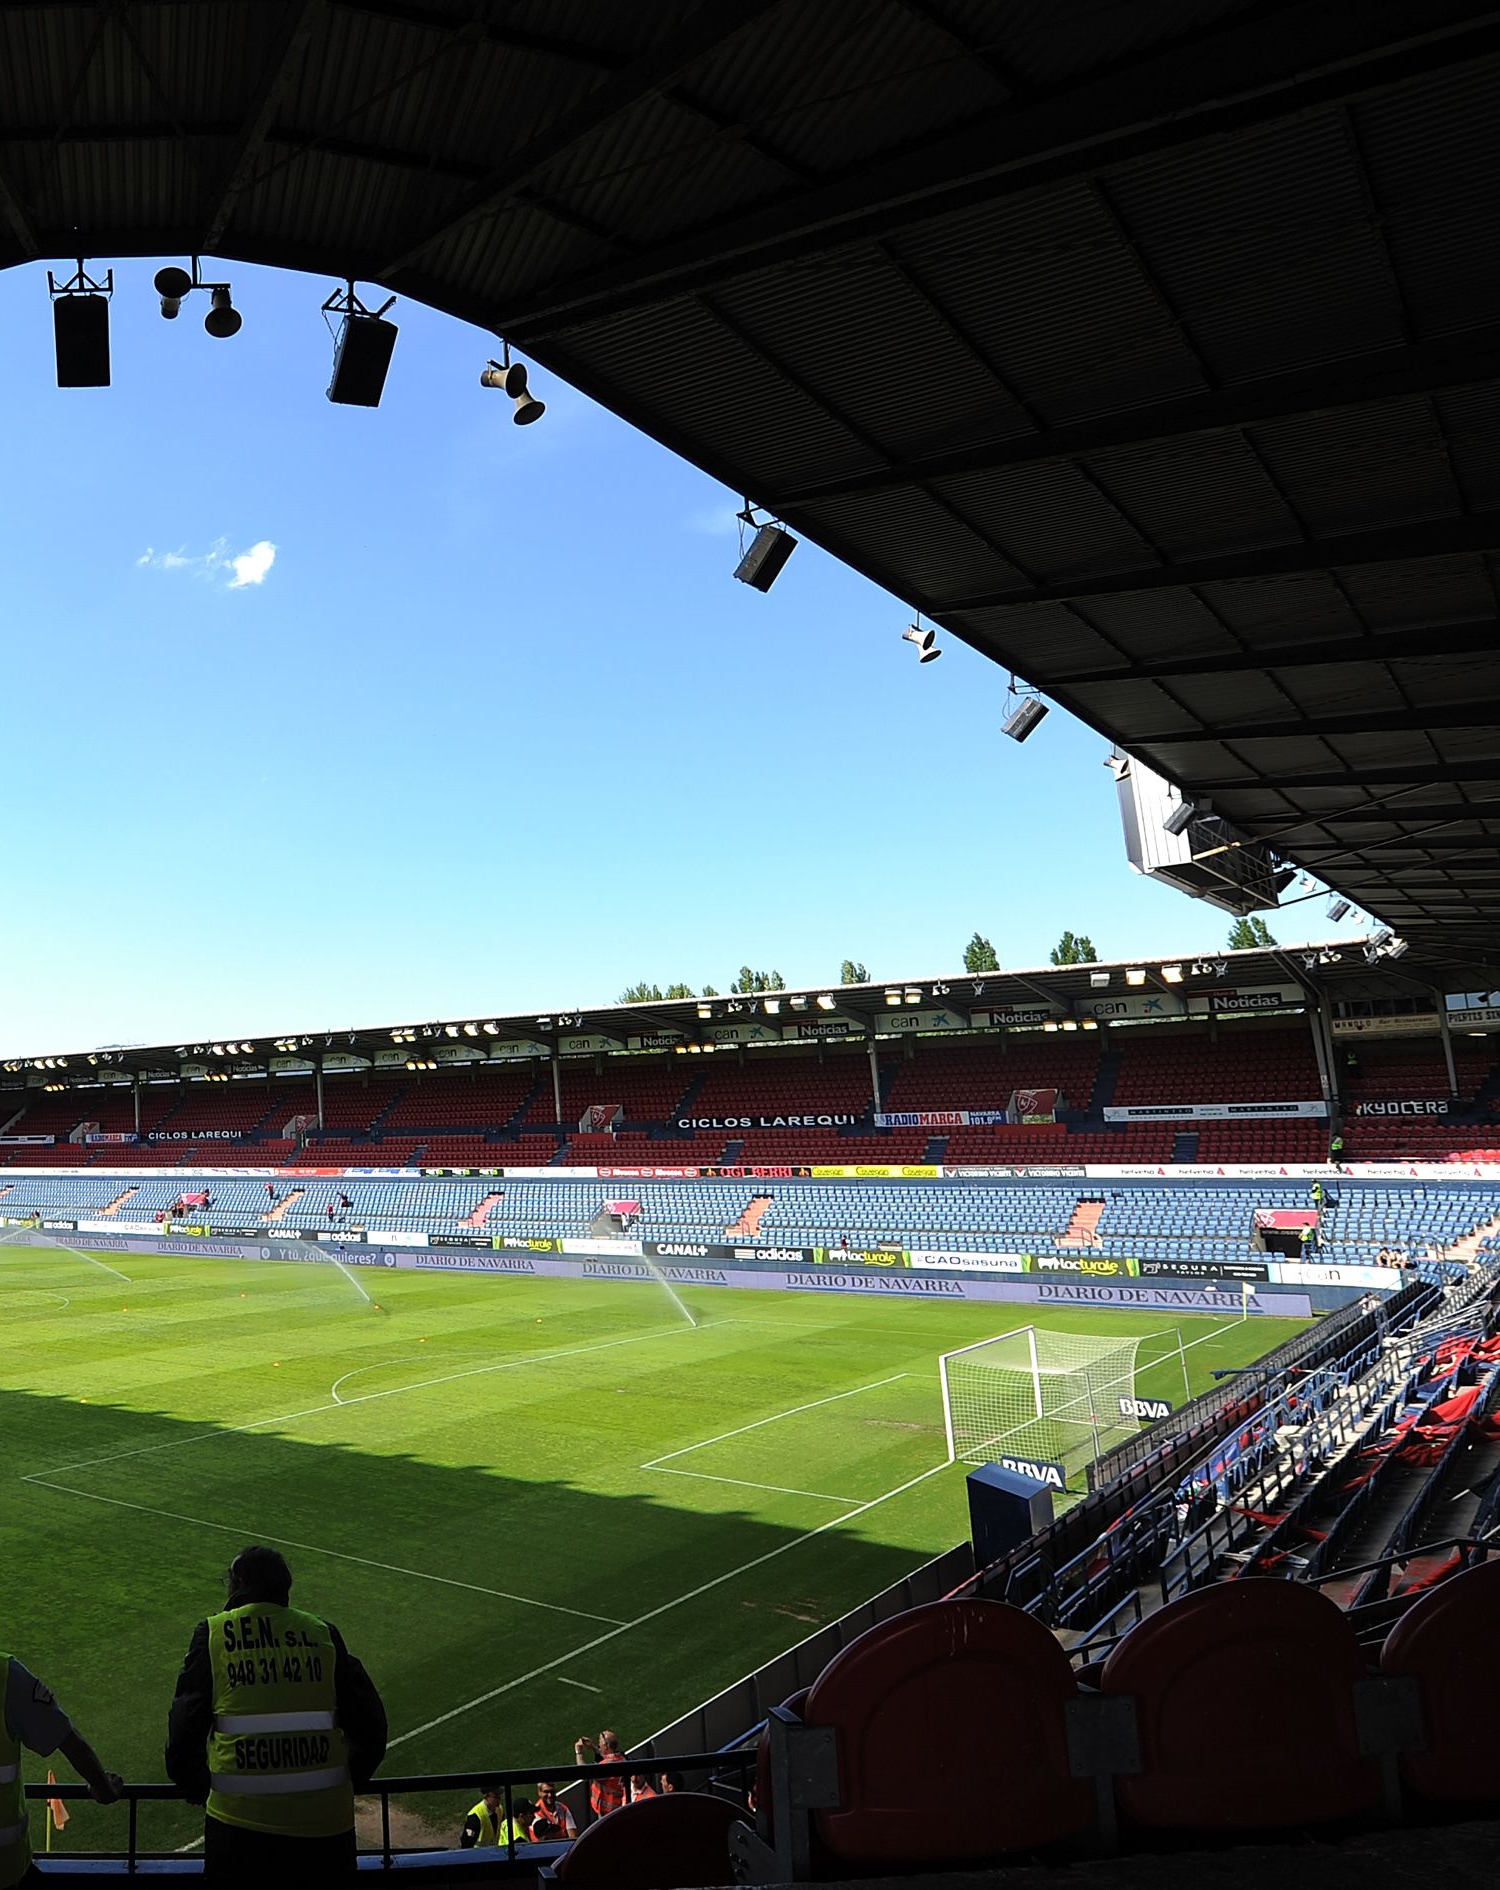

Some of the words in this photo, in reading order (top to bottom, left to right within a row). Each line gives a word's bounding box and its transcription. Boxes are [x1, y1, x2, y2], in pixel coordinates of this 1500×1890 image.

[1093, 1001, 1127, 1015] can
[1214, 995, 1279, 1010] Noticias
[891, 1016, 920, 1028] can
[993, 1011, 1050, 1024] Noticias
[714, 1028, 739, 1039] can
[802, 1024, 848, 1037] Noticias
[500, 1044, 519, 1054] can
[569, 1038, 590, 1050] can
[330, 1056, 347, 1065] can
[382, 1052, 399, 1062] can
[276, 1060, 292, 1068] can
[678, 1118, 752, 1128] CICLOS
[760, 1115, 855, 1127] LAREQUI
[148, 1132, 187, 1140] CICLOS
[191, 1130, 242, 1139] LAREQUI
[268, 1228, 301, 1239] CANAL+
[331, 1232, 362, 1243] adidas
[158, 1242, 187, 1252] DIARIO
[189, 1243, 200, 1252] DE
[202, 1244, 242, 1255] NAVARRA
[657, 1243, 708, 1256] CANAL+
[279, 1249, 287, 1259] Y
[303, 1250, 328, 1263] ¿qué
[331, 1252, 376, 1265] quieres?
[416, 1254, 458, 1265] DIARIO
[462, 1257, 476, 1267] DE
[478, 1258, 534, 1270] NAVARRA
[756, 1249, 803, 1262] adidas
[847, 1252, 896, 1266] lacturale
[584, 1264, 633, 1276] DIARIO
[635, 1265, 652, 1277] DE
[660, 1267, 727, 1281] NAVARRA
[1060, 1259, 1119, 1275] lacturale
[1162, 1263, 1218, 1273] SEGURA
[787, 1273, 847, 1287] DIARIO
[851, 1276, 875, 1288] DE
[879, 1277, 964, 1292] NAVARRA
[1039, 1285, 1113, 1300] DIARIO
[1119, 1289, 1150, 1303] DE
[1154, 1290, 1262, 1307] NAVARRA
[1120, 1398, 1170, 1419] BBVA
[1002, 1458, 1064, 1488] BBVA
[224, 1616, 279, 1652] S.E.N.
[227, 1660, 255, 1688] 948
[260, 1657, 278, 1684] 31
[283, 1656, 302, 1682] 42
[306, 1655, 322, 1682] 10
[235, 1735, 330, 1770] SEGURIDAD
